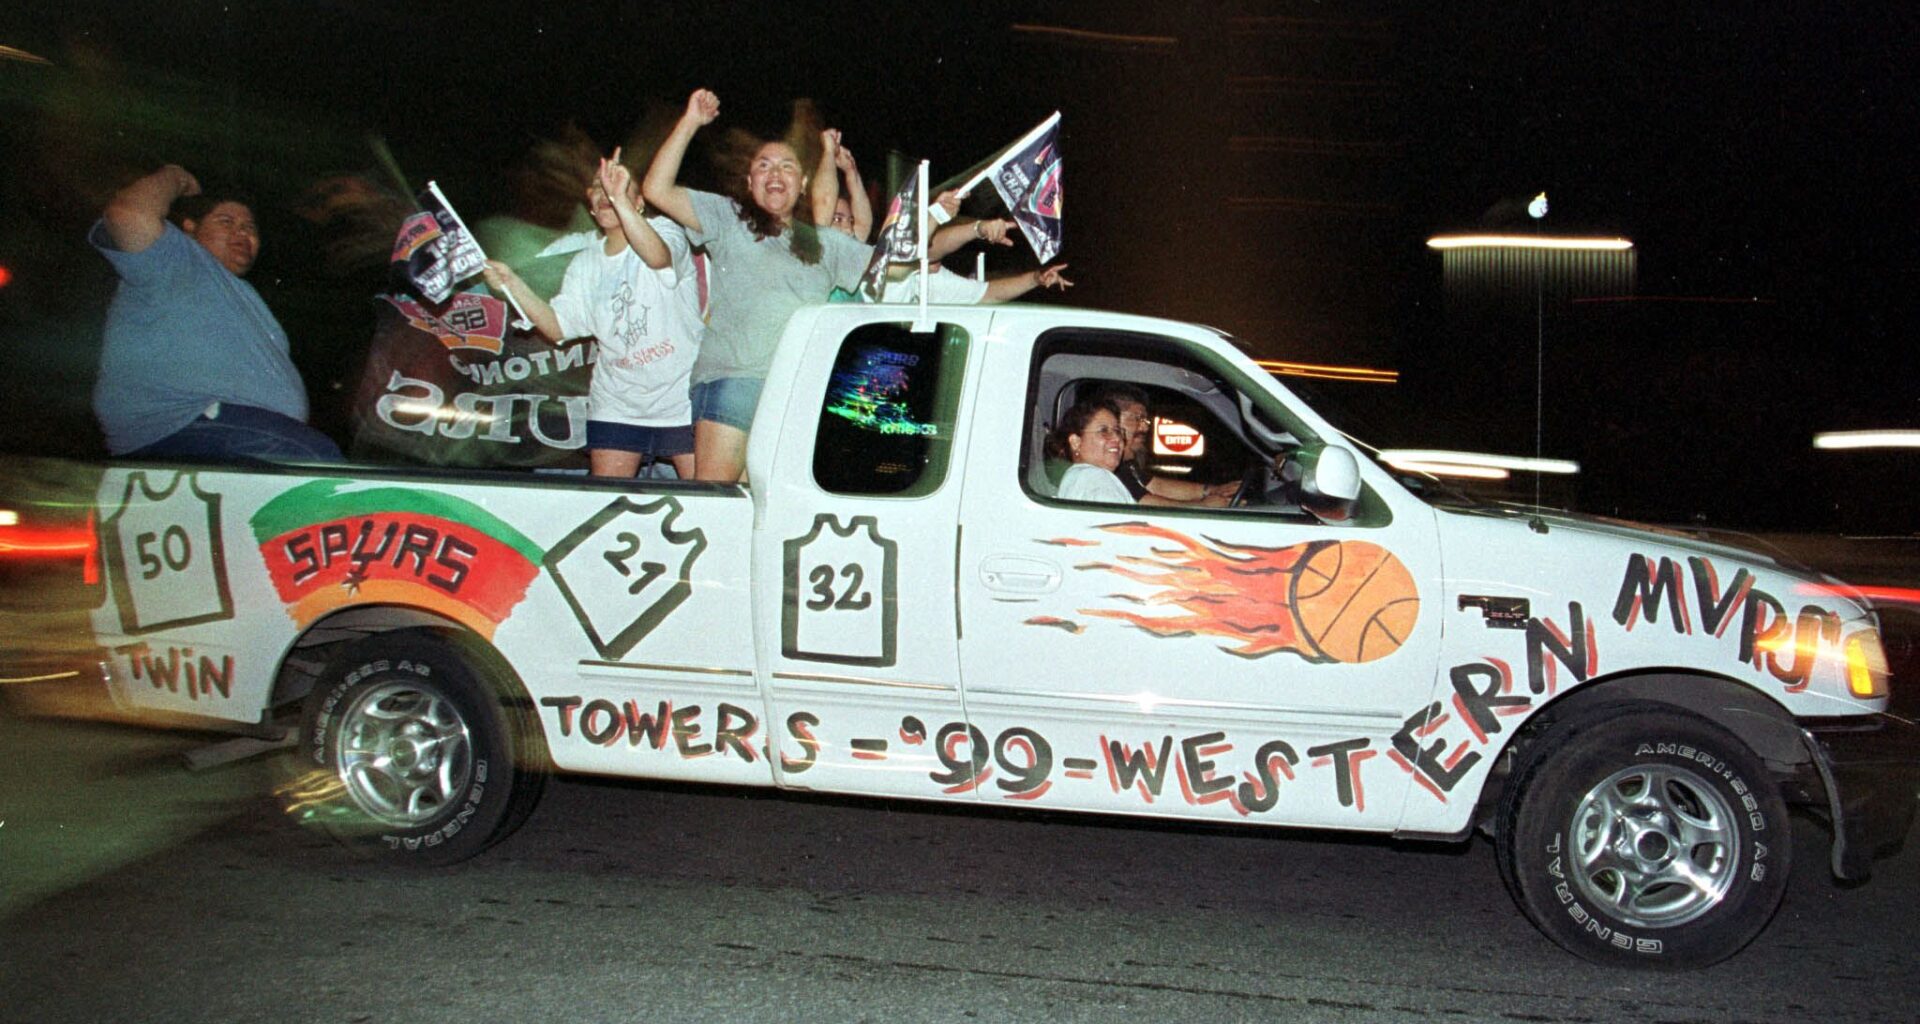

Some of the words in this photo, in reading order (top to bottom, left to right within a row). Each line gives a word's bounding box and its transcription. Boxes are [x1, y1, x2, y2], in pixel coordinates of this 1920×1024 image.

[136, 524, 192, 581] 50
[283, 520, 478, 595] SPURS
[603, 531, 667, 595] 21
[806, 562, 872, 611] 32
[540, 694, 822, 774] TOWERS
[382, 760, 488, 849] GENERAL
[1547, 833, 1662, 954] GENERAL
